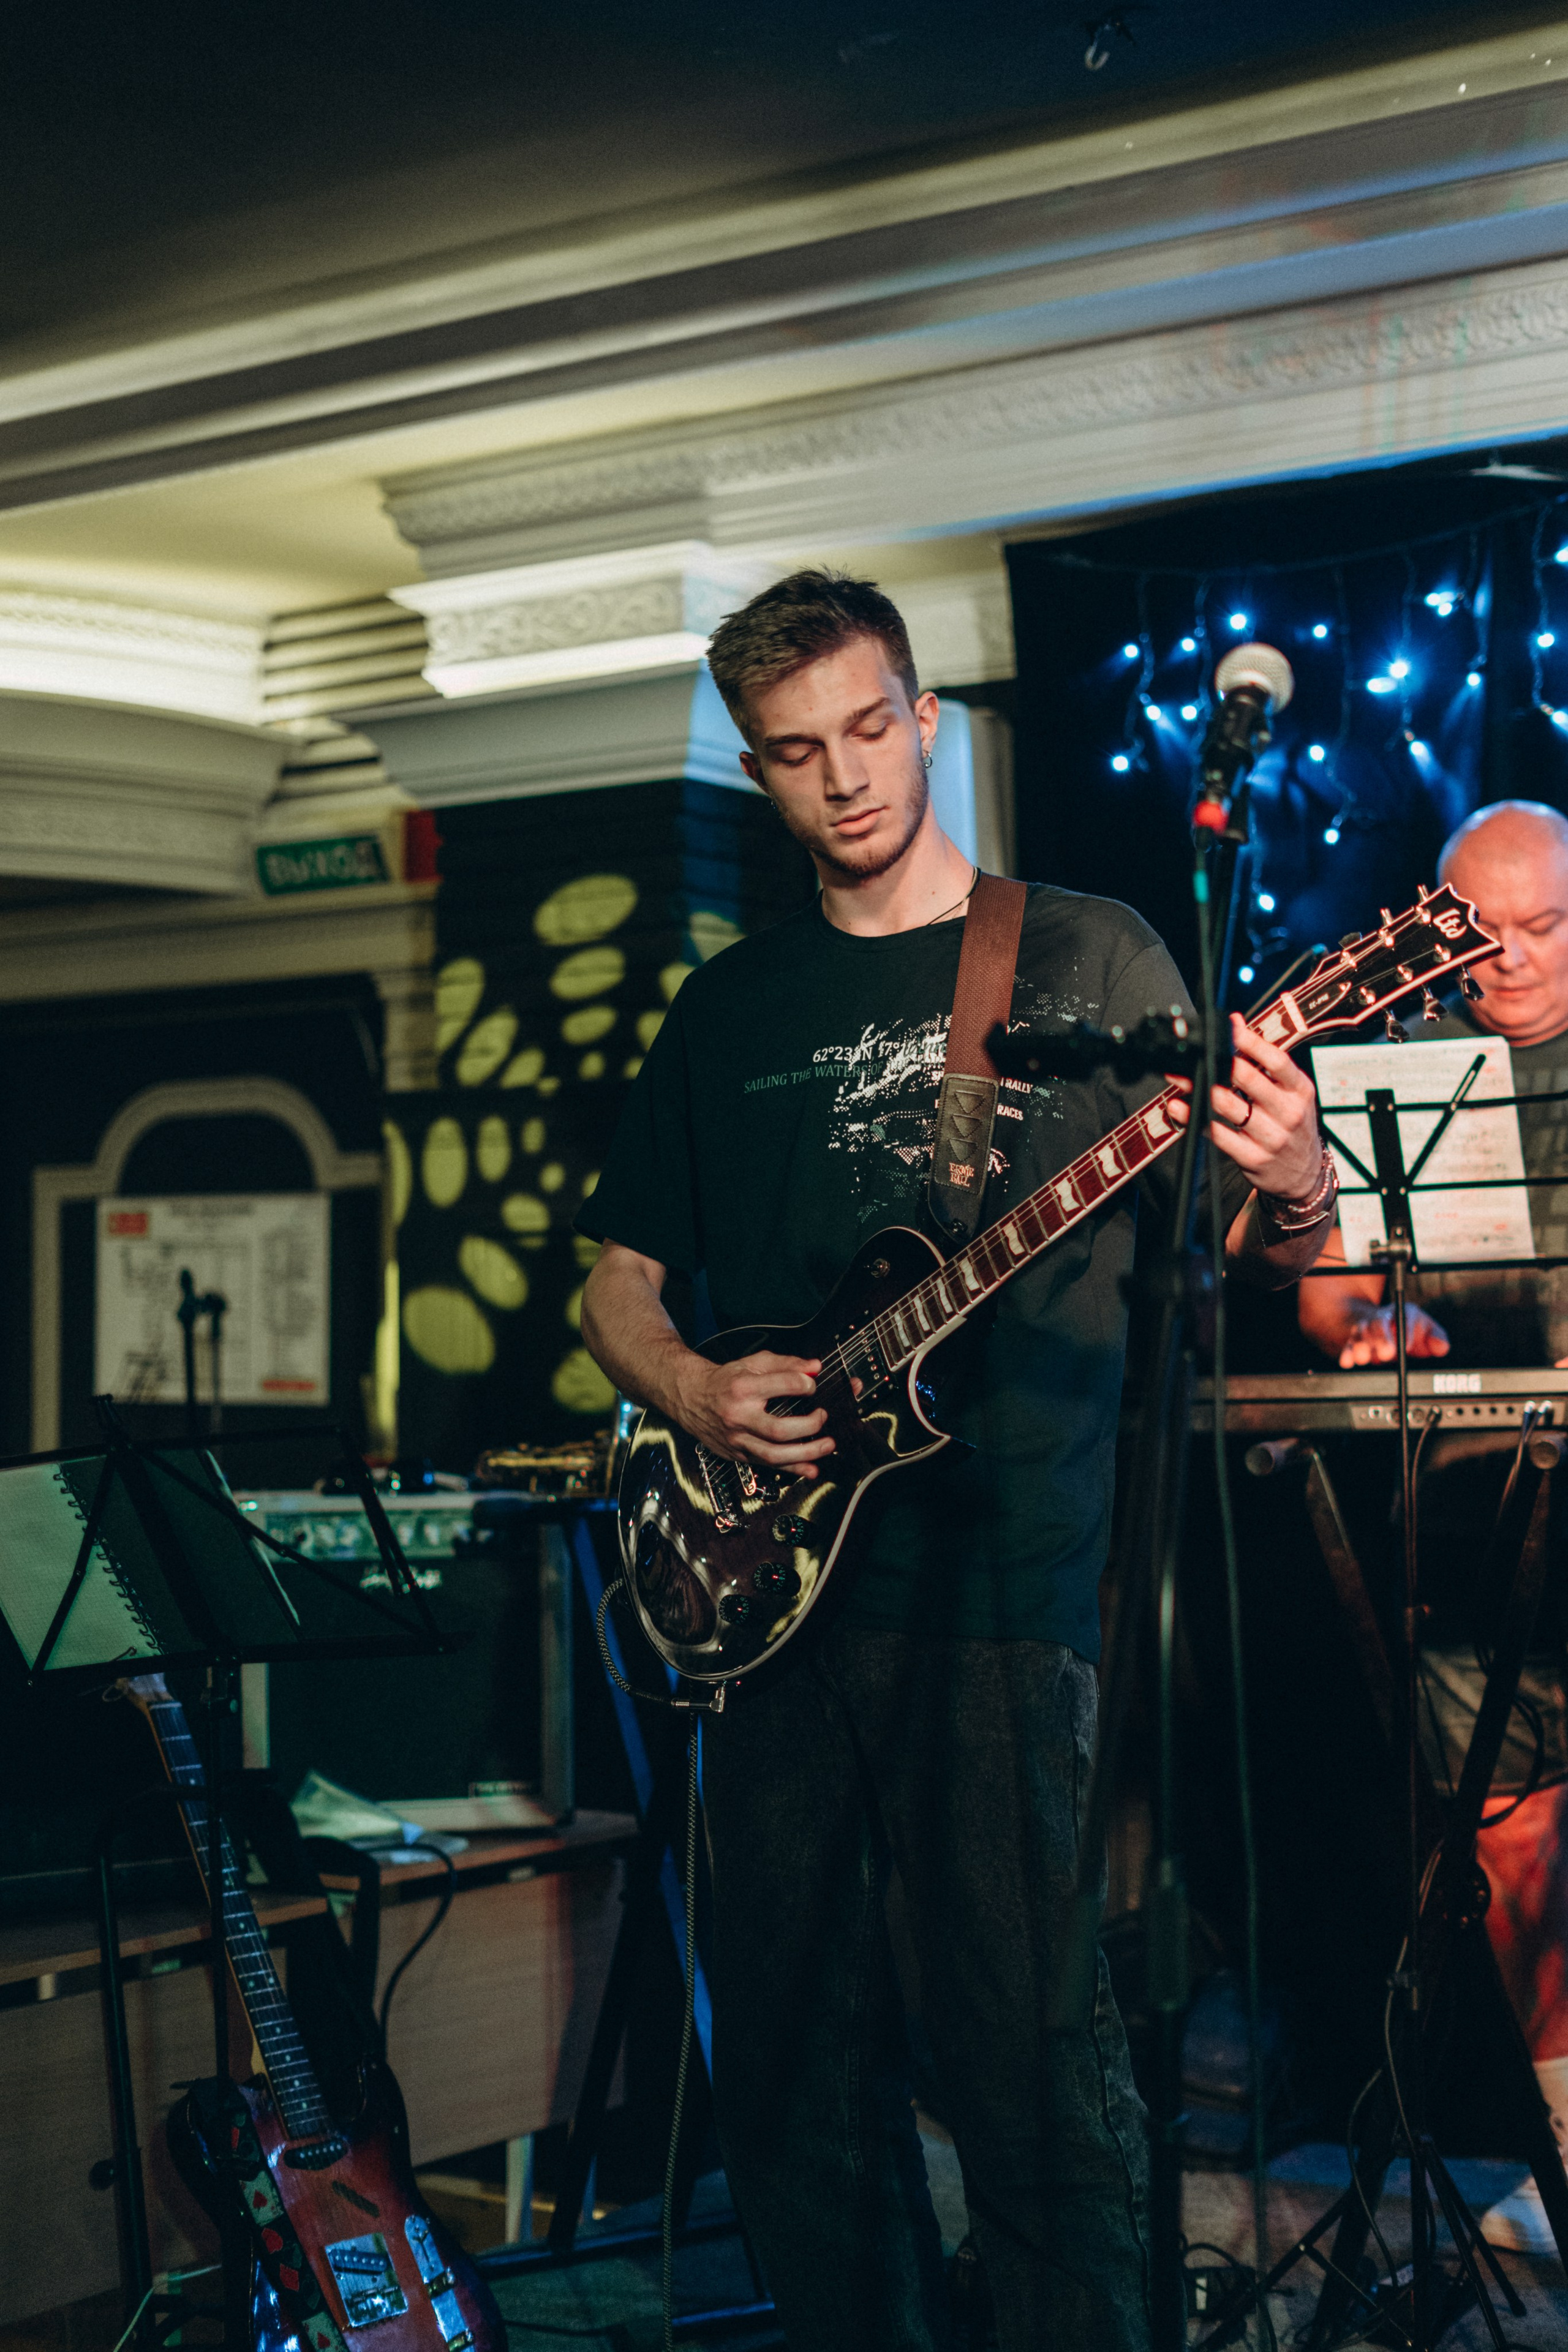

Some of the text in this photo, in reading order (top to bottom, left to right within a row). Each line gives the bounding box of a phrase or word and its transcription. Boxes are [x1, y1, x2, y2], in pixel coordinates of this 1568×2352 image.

[744, 1074, 787, 1093] SAILING
[791, 1068, 812, 1084] THE
[815, 1065, 868, 1077] WATERS
[870, 1061, 883, 1076] OF
[1005, 1079, 1032, 1094] RALLY
[997, 1104, 1023, 1120] RACES
[950, 1172, 970, 1186] BALL
[1434, 1374, 1481, 1393] KORG
